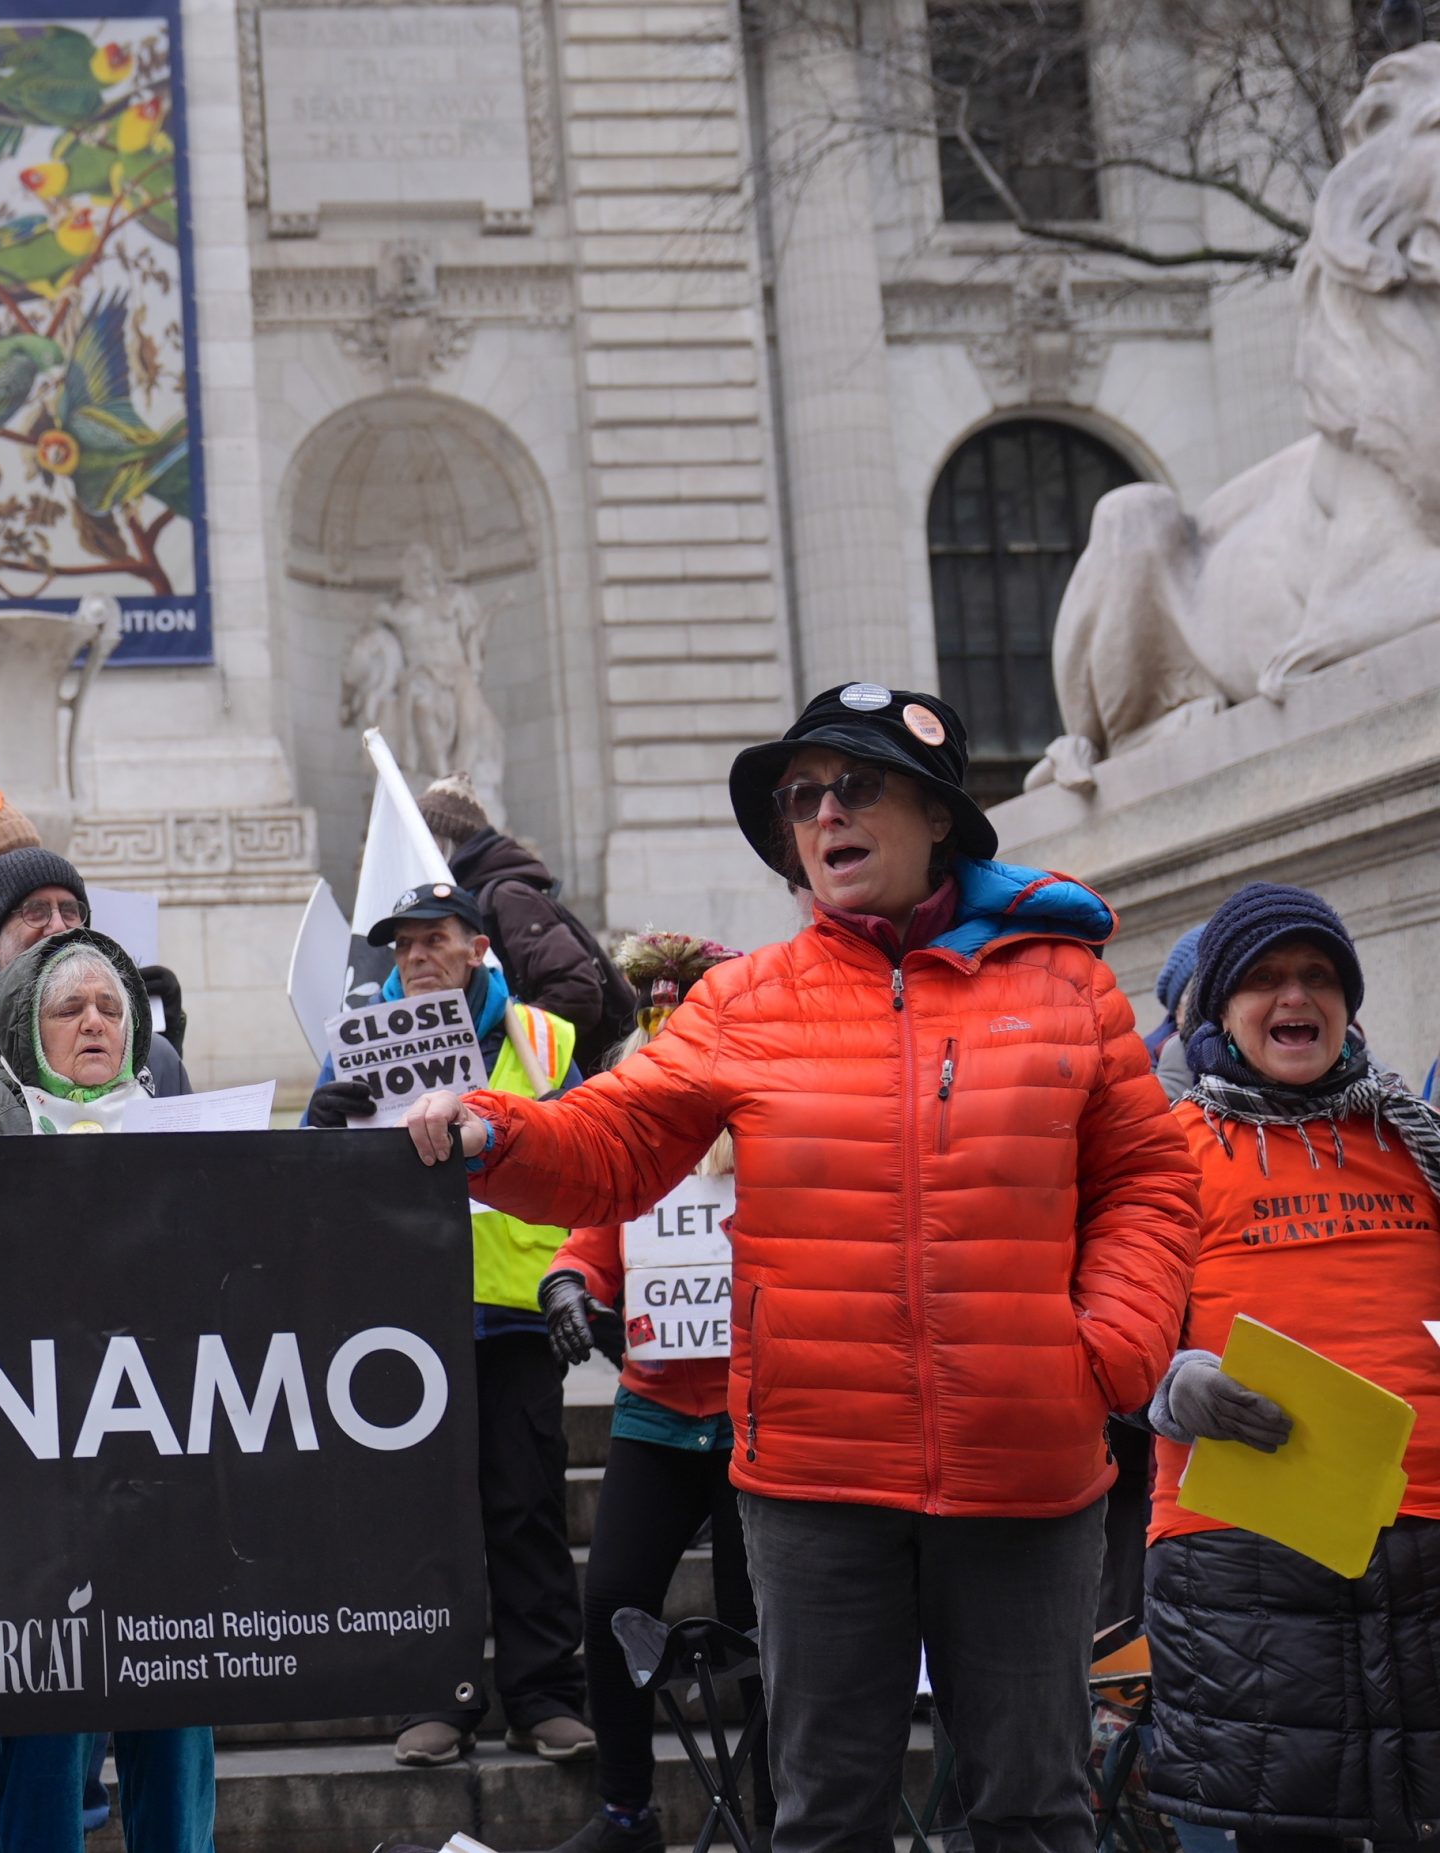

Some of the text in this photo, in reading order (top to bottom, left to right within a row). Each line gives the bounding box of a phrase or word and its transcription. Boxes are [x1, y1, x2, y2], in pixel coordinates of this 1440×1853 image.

[120, 609, 197, 632] ITION
[339, 1000, 463, 1046] CLOSE
[338, 1032, 474, 1069] GUANTANAMO
[352, 1055, 471, 1100] NOW!
[657, 1204, 721, 1237] LET
[1253, 1192, 1415, 1220] SHUT DOWN
[644, 1277, 732, 1307] GAZA
[660, 1320, 728, 1348] LIVE
[117, 1606, 450, 1642] National Religious Campaign
[118, 1652, 297, 1688] Against Torture
